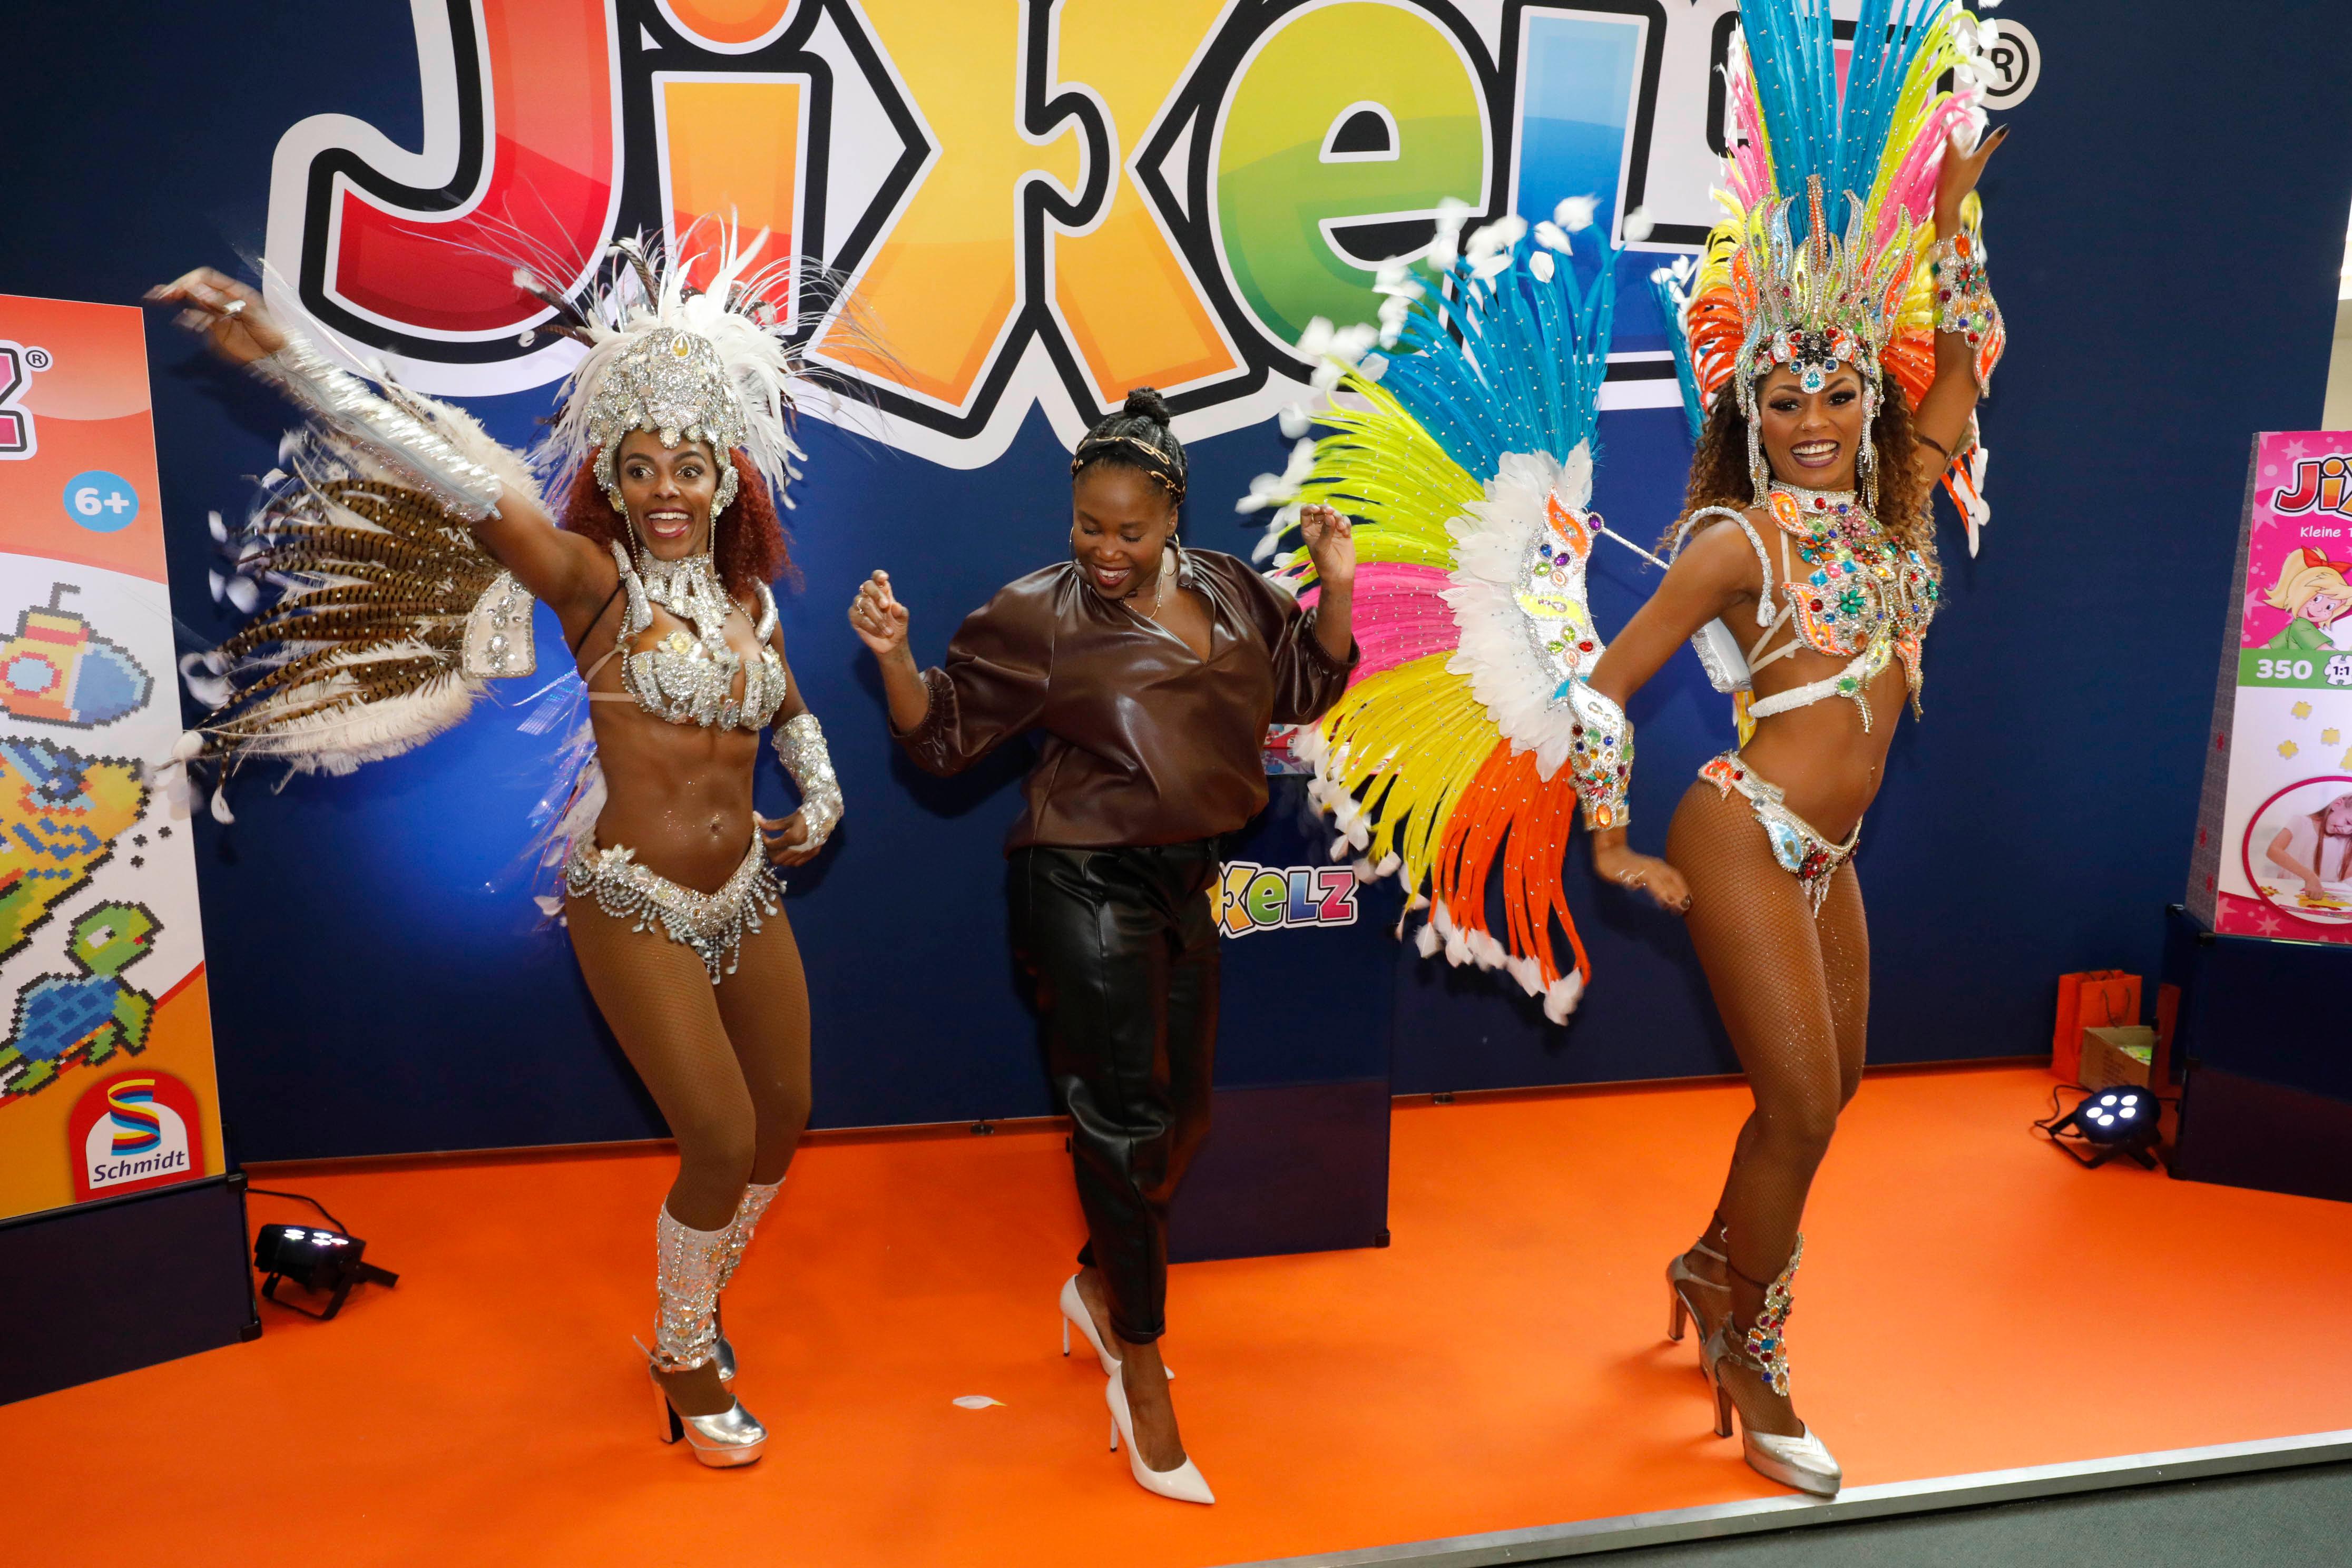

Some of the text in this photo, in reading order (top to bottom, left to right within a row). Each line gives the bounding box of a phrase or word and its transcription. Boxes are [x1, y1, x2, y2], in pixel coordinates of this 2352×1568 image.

[75, 487, 130, 516] 6+
[2300, 525, 2341, 537] Kleine
[2256, 659, 2350, 680] 350 1:1
[93, 1150, 186, 1182] Schmidt
